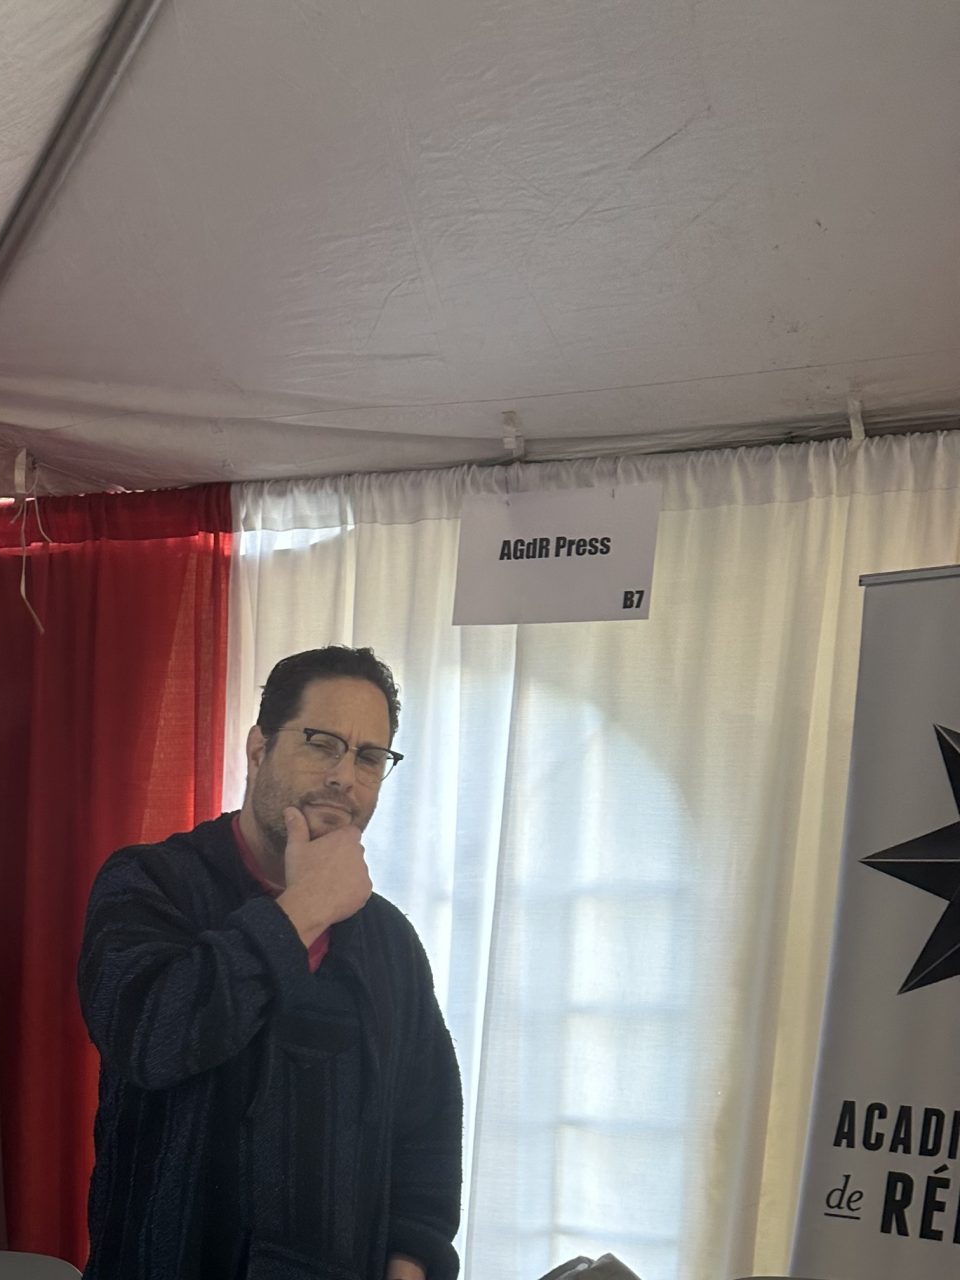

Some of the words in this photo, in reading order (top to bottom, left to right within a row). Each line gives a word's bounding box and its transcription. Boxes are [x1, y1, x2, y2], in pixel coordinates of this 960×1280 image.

[499, 538, 550, 561] AGdR
[554, 536, 611, 558] Press
[622, 590, 645, 609] B7
[824, 1174, 864, 1220] de
[880, 1164, 960, 1245] RÉ
